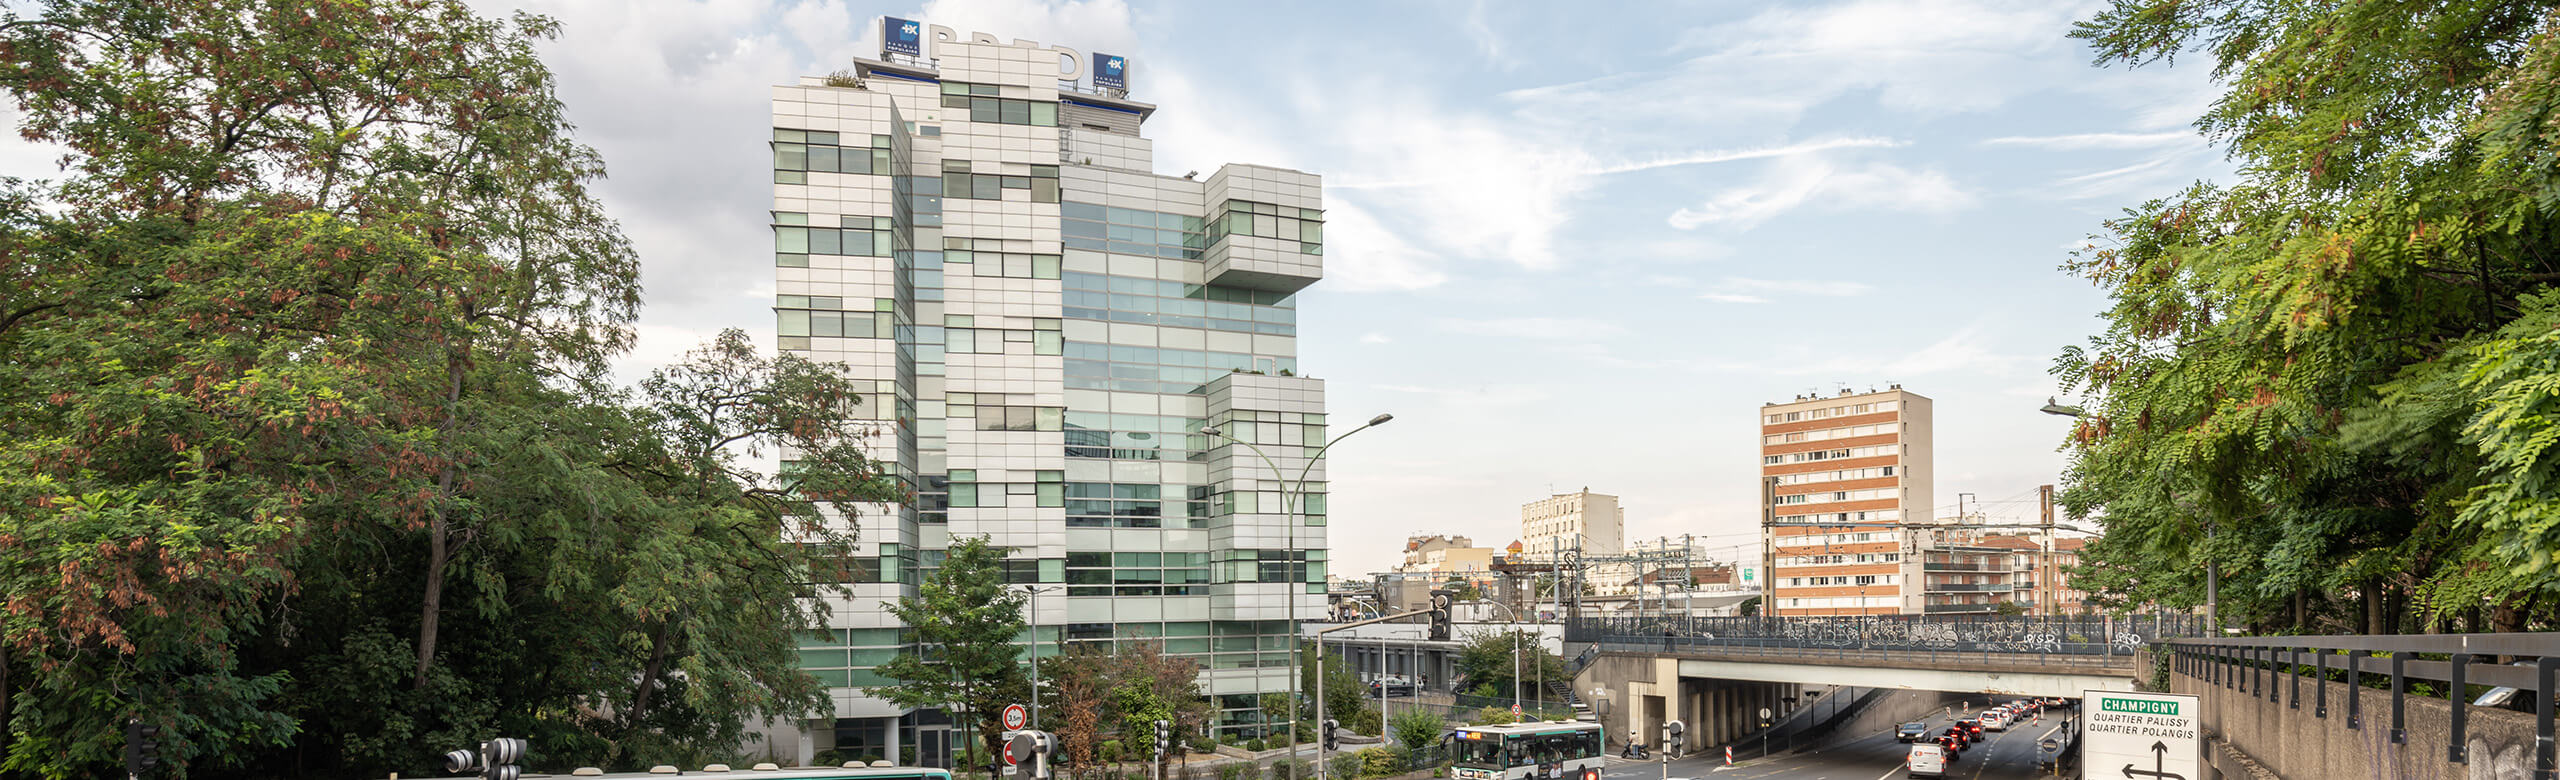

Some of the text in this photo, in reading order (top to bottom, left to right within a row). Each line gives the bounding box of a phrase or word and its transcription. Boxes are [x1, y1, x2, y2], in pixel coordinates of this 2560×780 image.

[2103, 699, 2177, 714] CHAMPIGNY
[2093, 712, 2190, 728] QUARTIER PALISSY
[2089, 722, 2194, 739] QUARTIER POLANGIS
